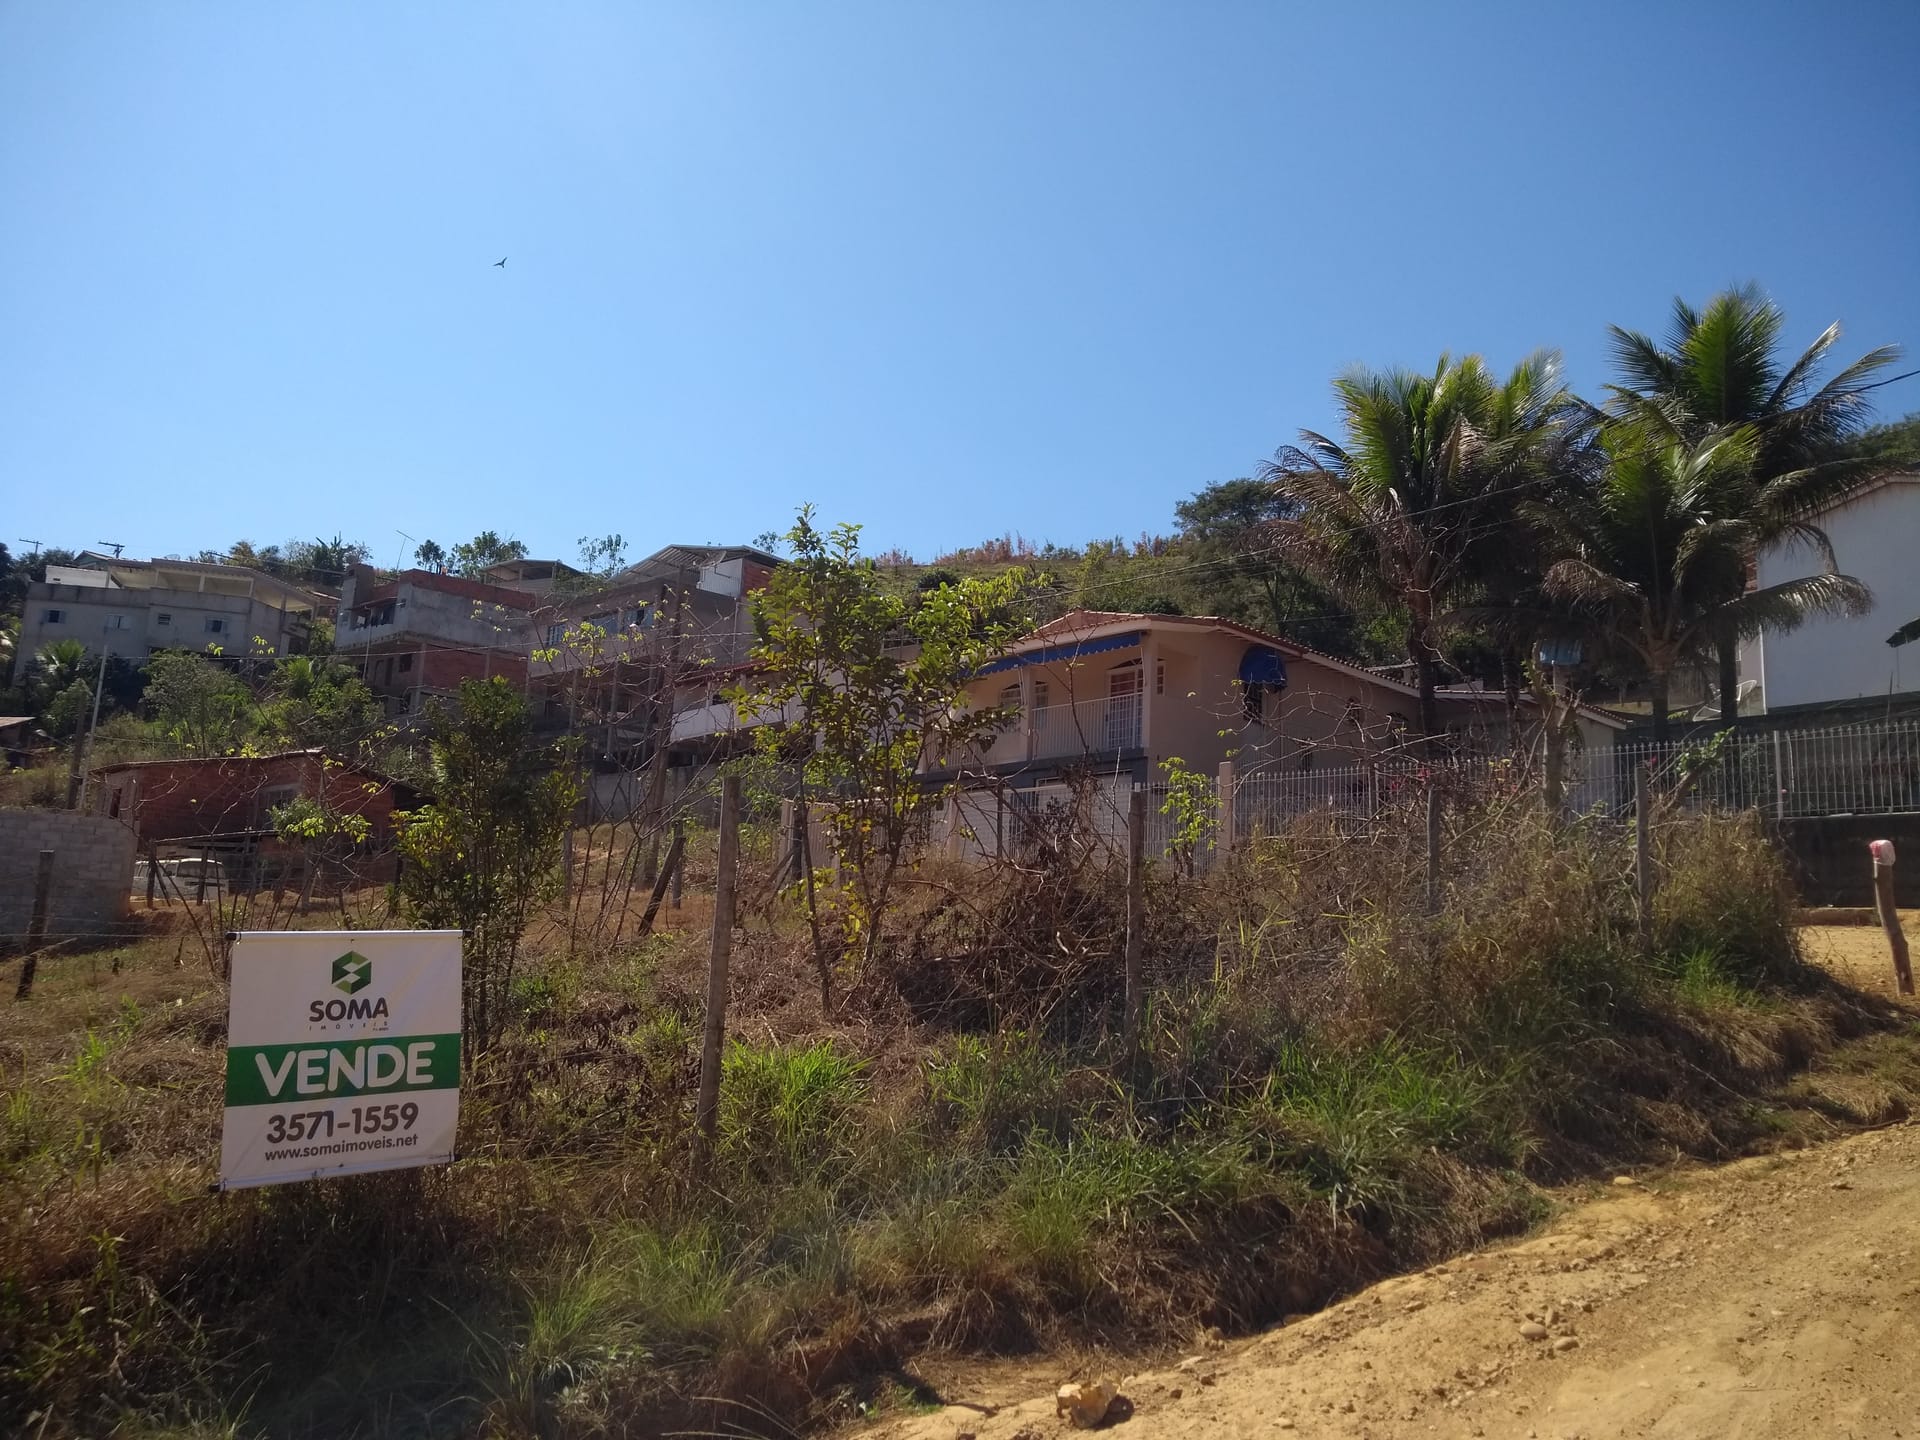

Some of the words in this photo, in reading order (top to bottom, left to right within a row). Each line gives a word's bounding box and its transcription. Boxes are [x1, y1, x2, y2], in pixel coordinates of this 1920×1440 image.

[309, 997, 389, 1022] SOMA
[255, 1042, 436, 1097] VENDE
[266, 1102, 419, 1144] 3571-1559
[265, 1134, 418, 1160] www.somaimoveis.net
